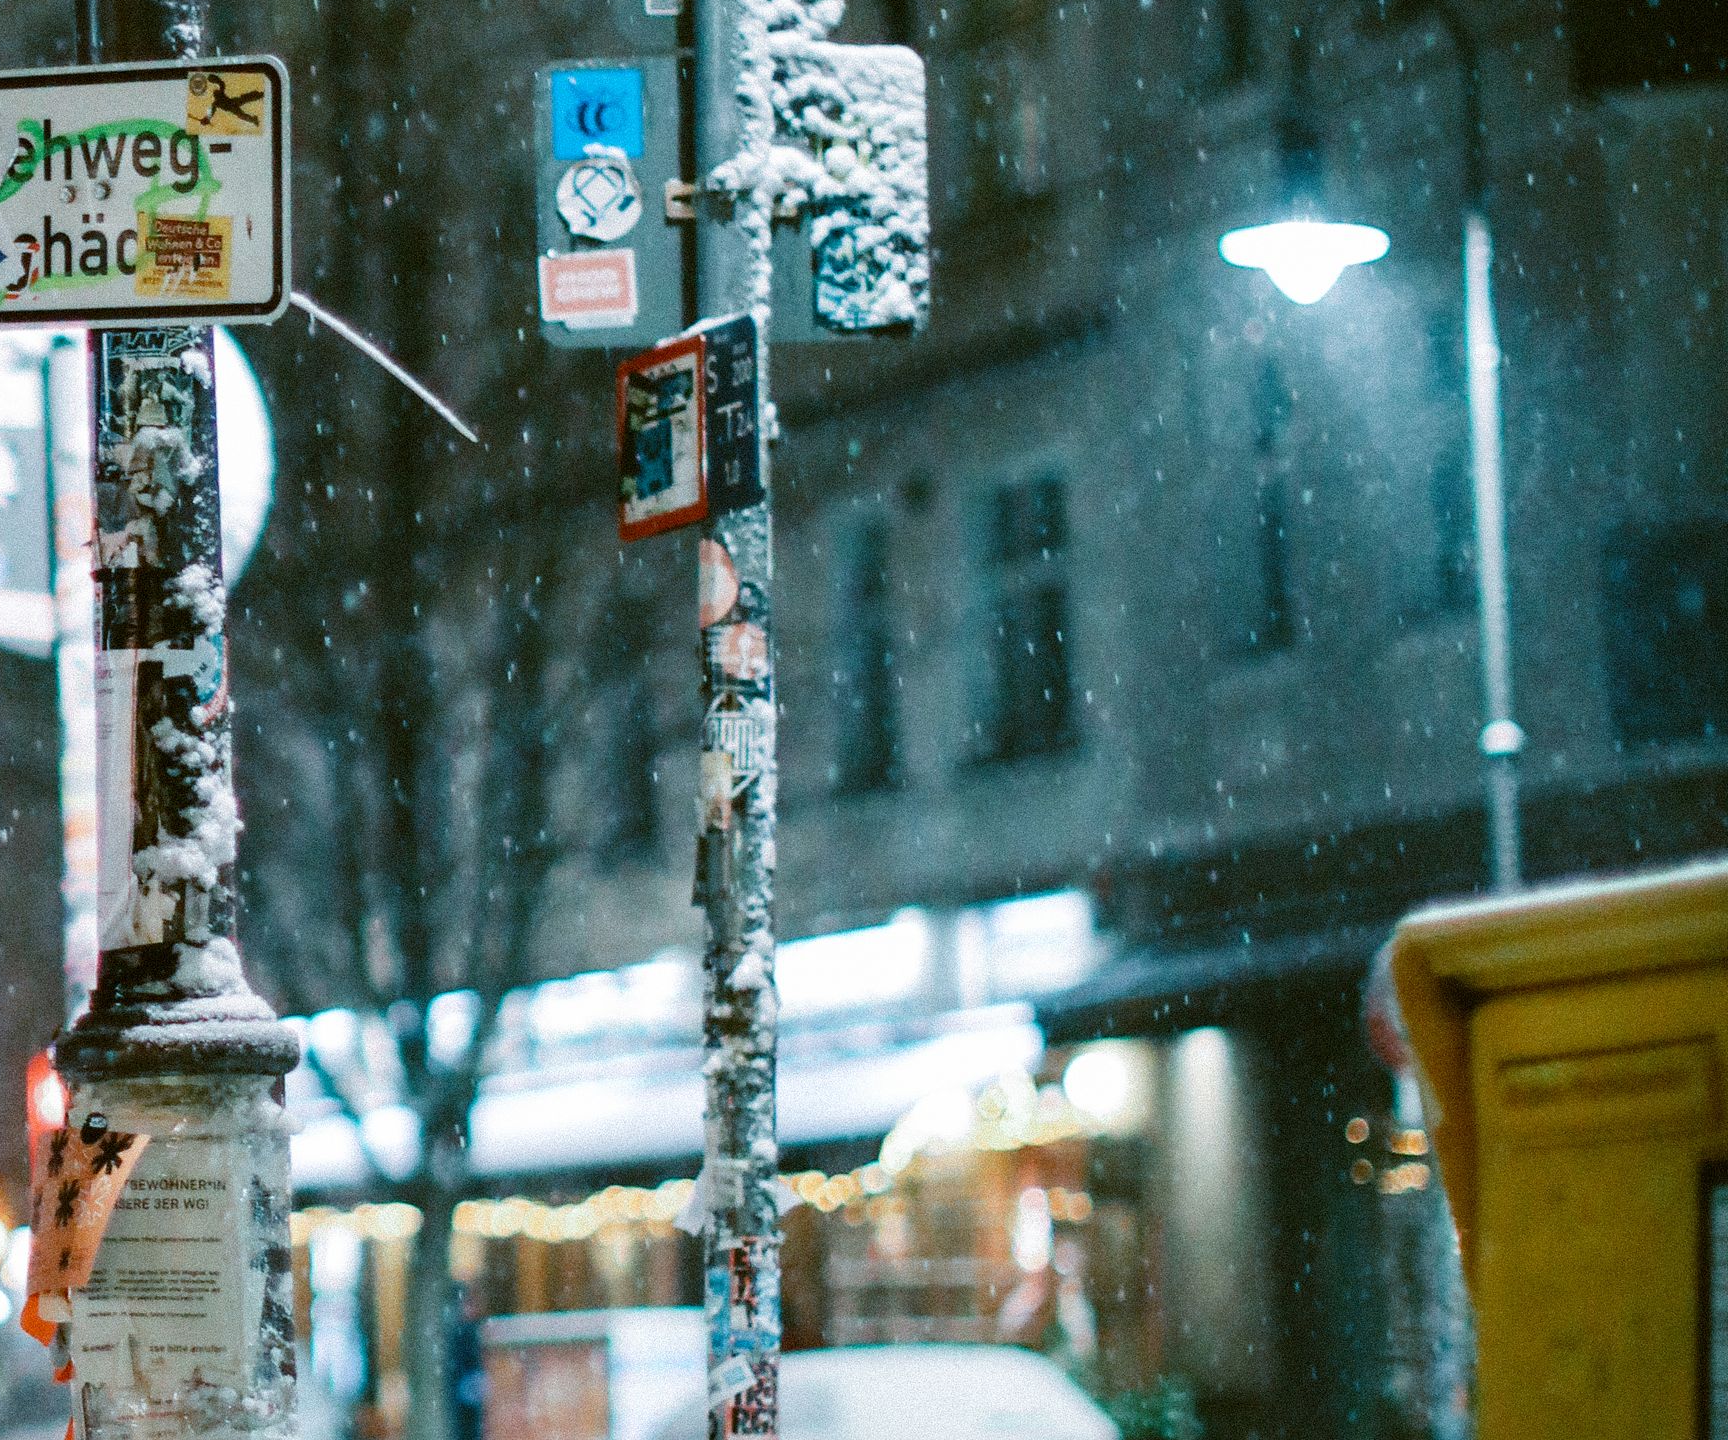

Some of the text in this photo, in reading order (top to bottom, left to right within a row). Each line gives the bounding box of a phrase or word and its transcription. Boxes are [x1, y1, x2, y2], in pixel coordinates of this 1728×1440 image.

[7, 119, 231, 192] ehweg-
[194, 236, 204, 249] &
[205, 237, 222, 248] Co
[125, 1178, 227, 1191] BEWOHNERIN
